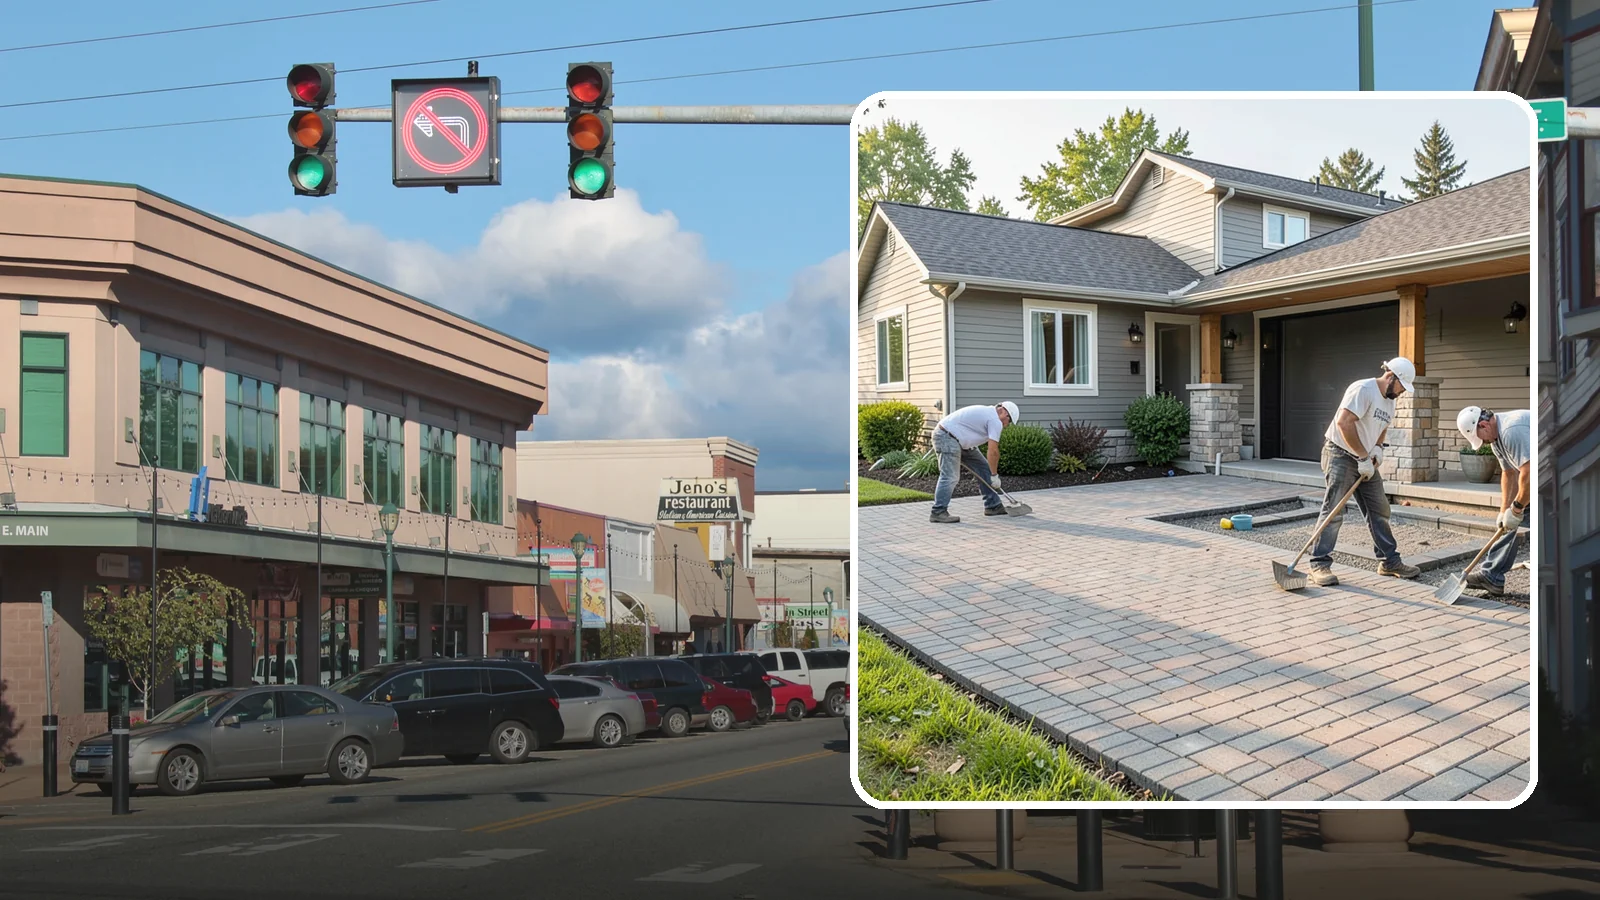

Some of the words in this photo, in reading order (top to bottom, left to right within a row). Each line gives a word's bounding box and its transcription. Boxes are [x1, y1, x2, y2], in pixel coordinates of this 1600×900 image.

[670, 480, 728, 494] Jeno's
[665, 496, 731, 509] restaurant
[658, 510, 682, 519] Italian
[686, 510, 714, 519] American
[715, 510, 737, 519] Cuisine
[2, 525, 12, 536] E.
[15, 525, 48, 536] MAIN
[786, 608, 795, 616] in
[797, 607, 828, 616] Street
